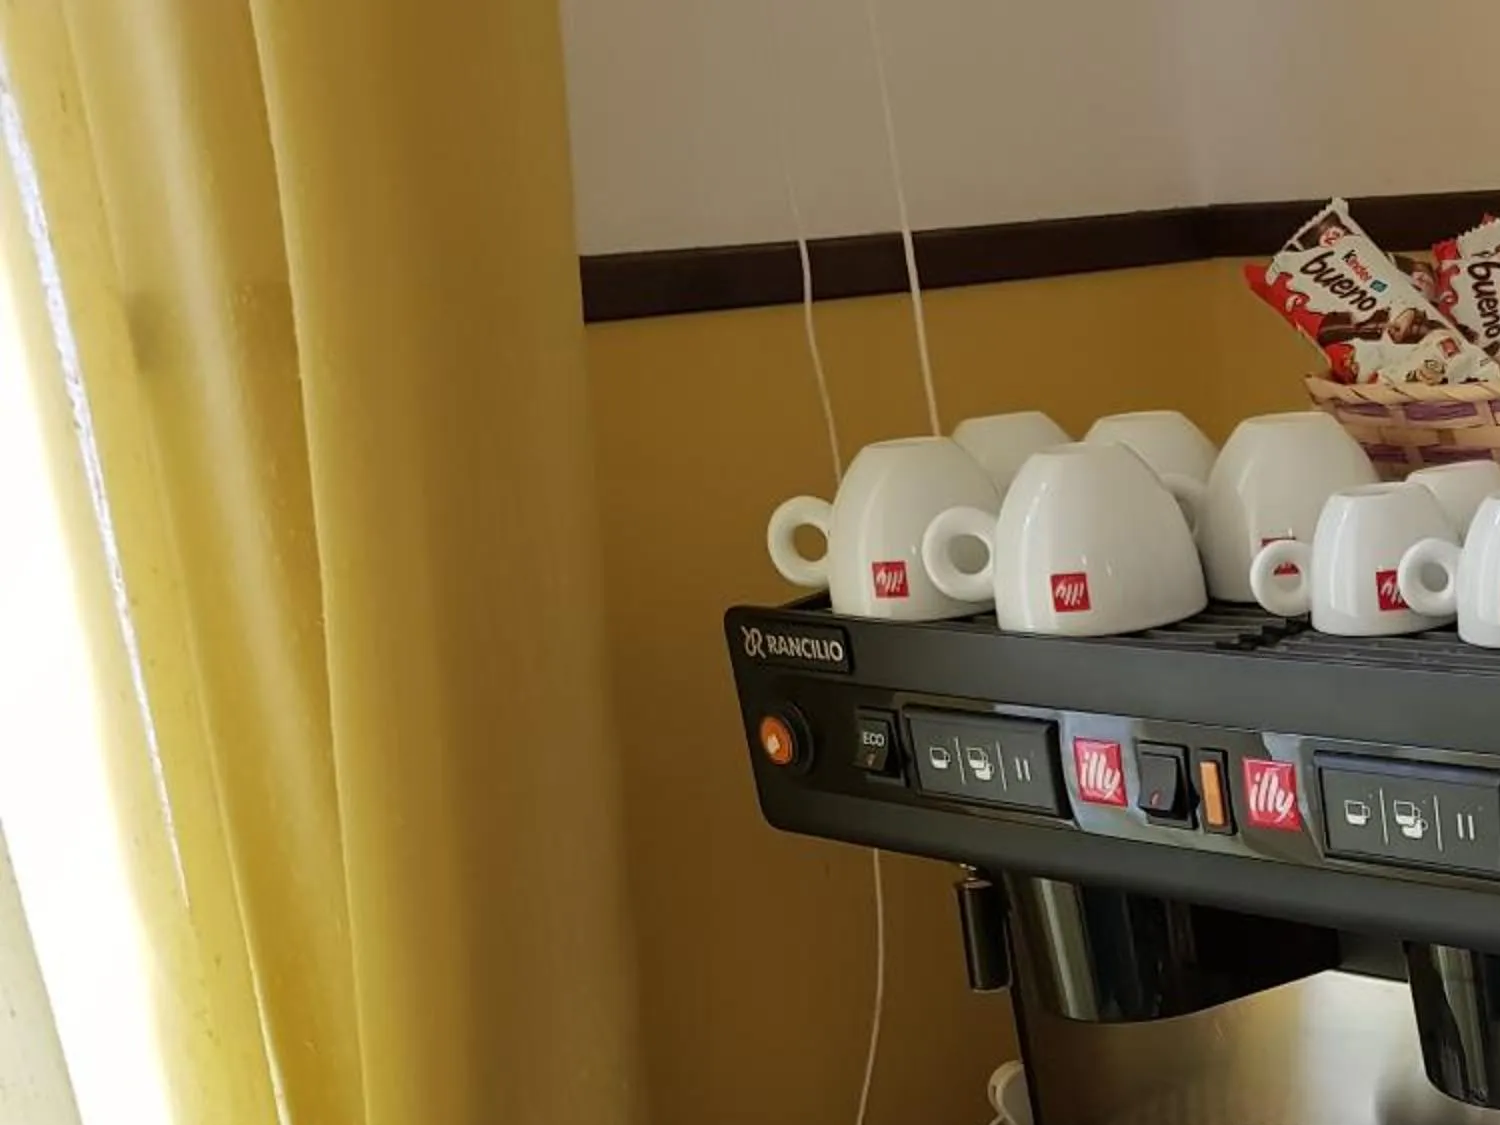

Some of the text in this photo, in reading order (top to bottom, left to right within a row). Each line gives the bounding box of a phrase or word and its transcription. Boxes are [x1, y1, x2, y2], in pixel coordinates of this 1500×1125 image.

[1300, 250, 1377, 312] bueno
[1055, 580, 1086, 606] illy
[765, 633, 844, 661] RANCILIO
[863, 730, 886, 747] ECO
[1079, 751, 1121, 800] illy
[1250, 769, 1294, 824] illy
